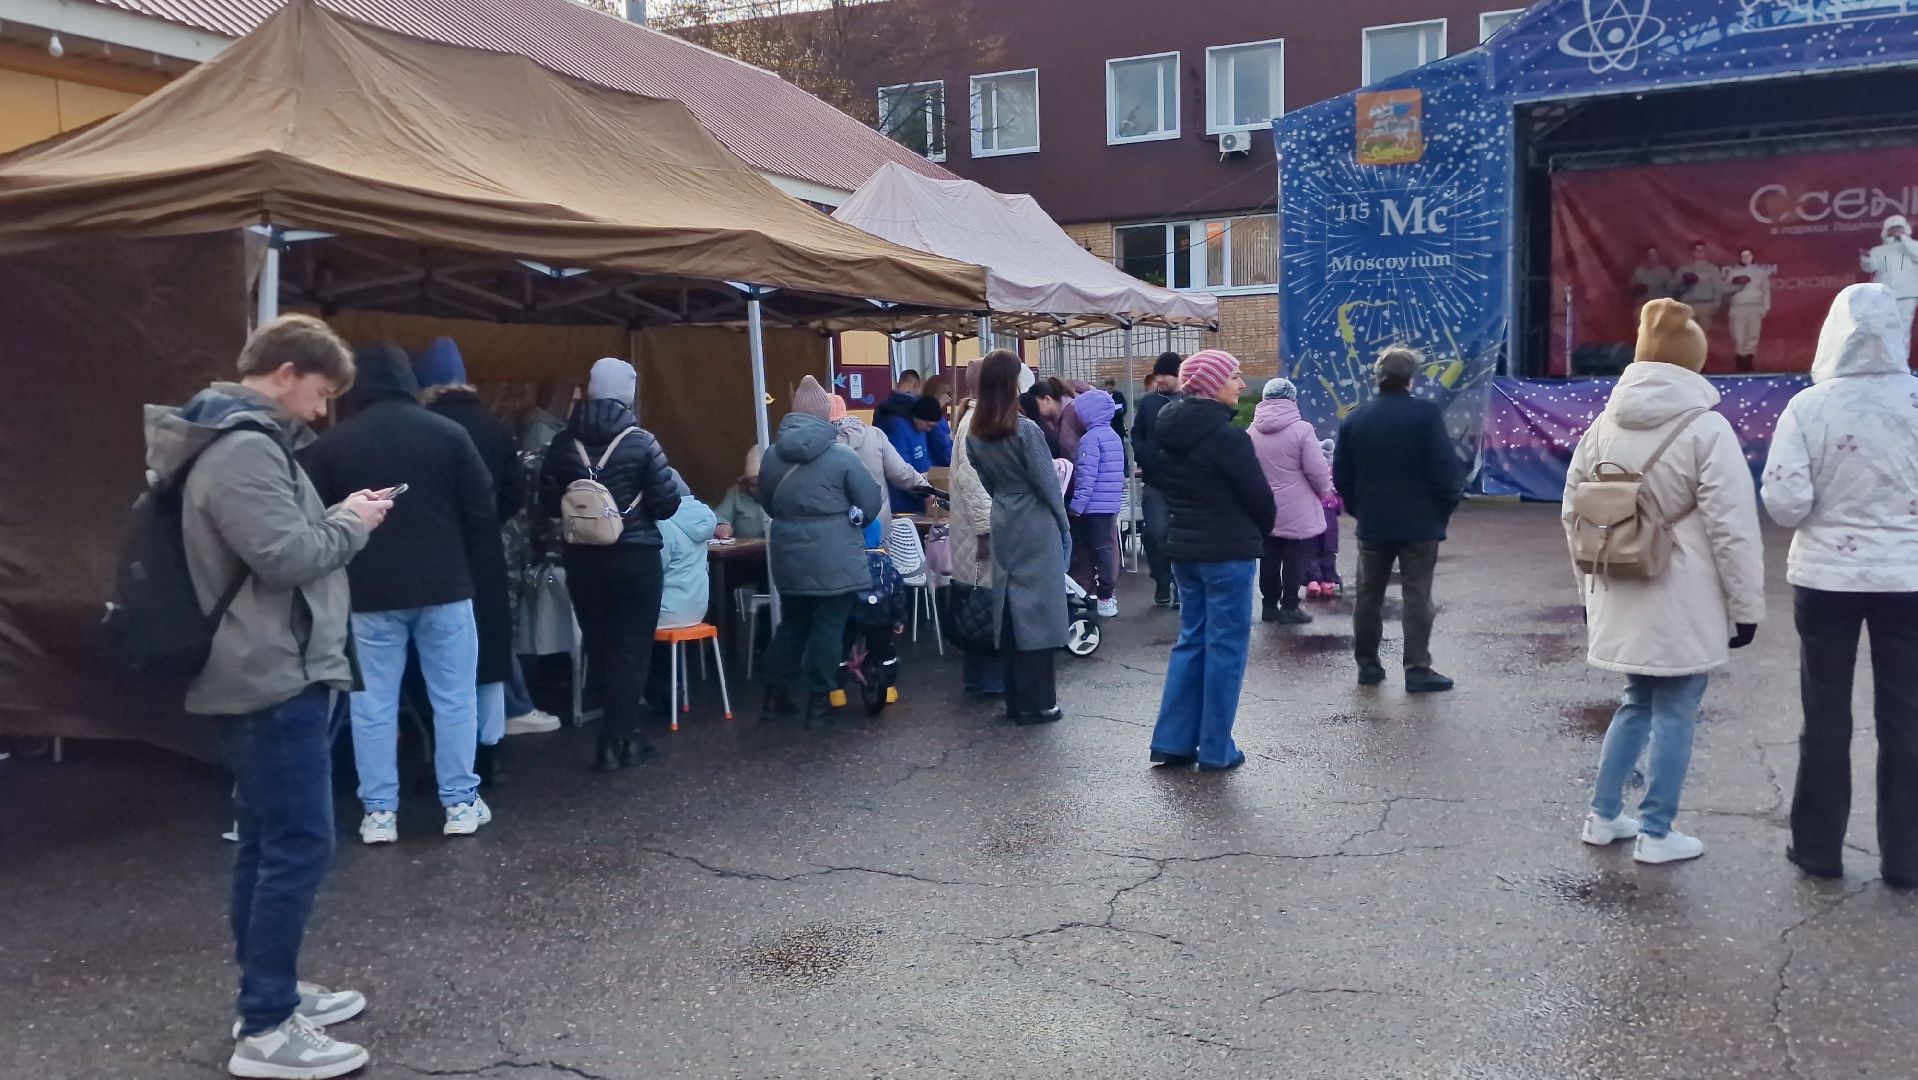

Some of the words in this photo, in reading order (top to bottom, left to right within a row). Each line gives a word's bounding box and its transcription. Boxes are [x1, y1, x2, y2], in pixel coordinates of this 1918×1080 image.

[1336, 202, 1369, 221] 115
[1380, 197, 1448, 236] Mc
[1331, 253, 1452, 272] Moscovium
